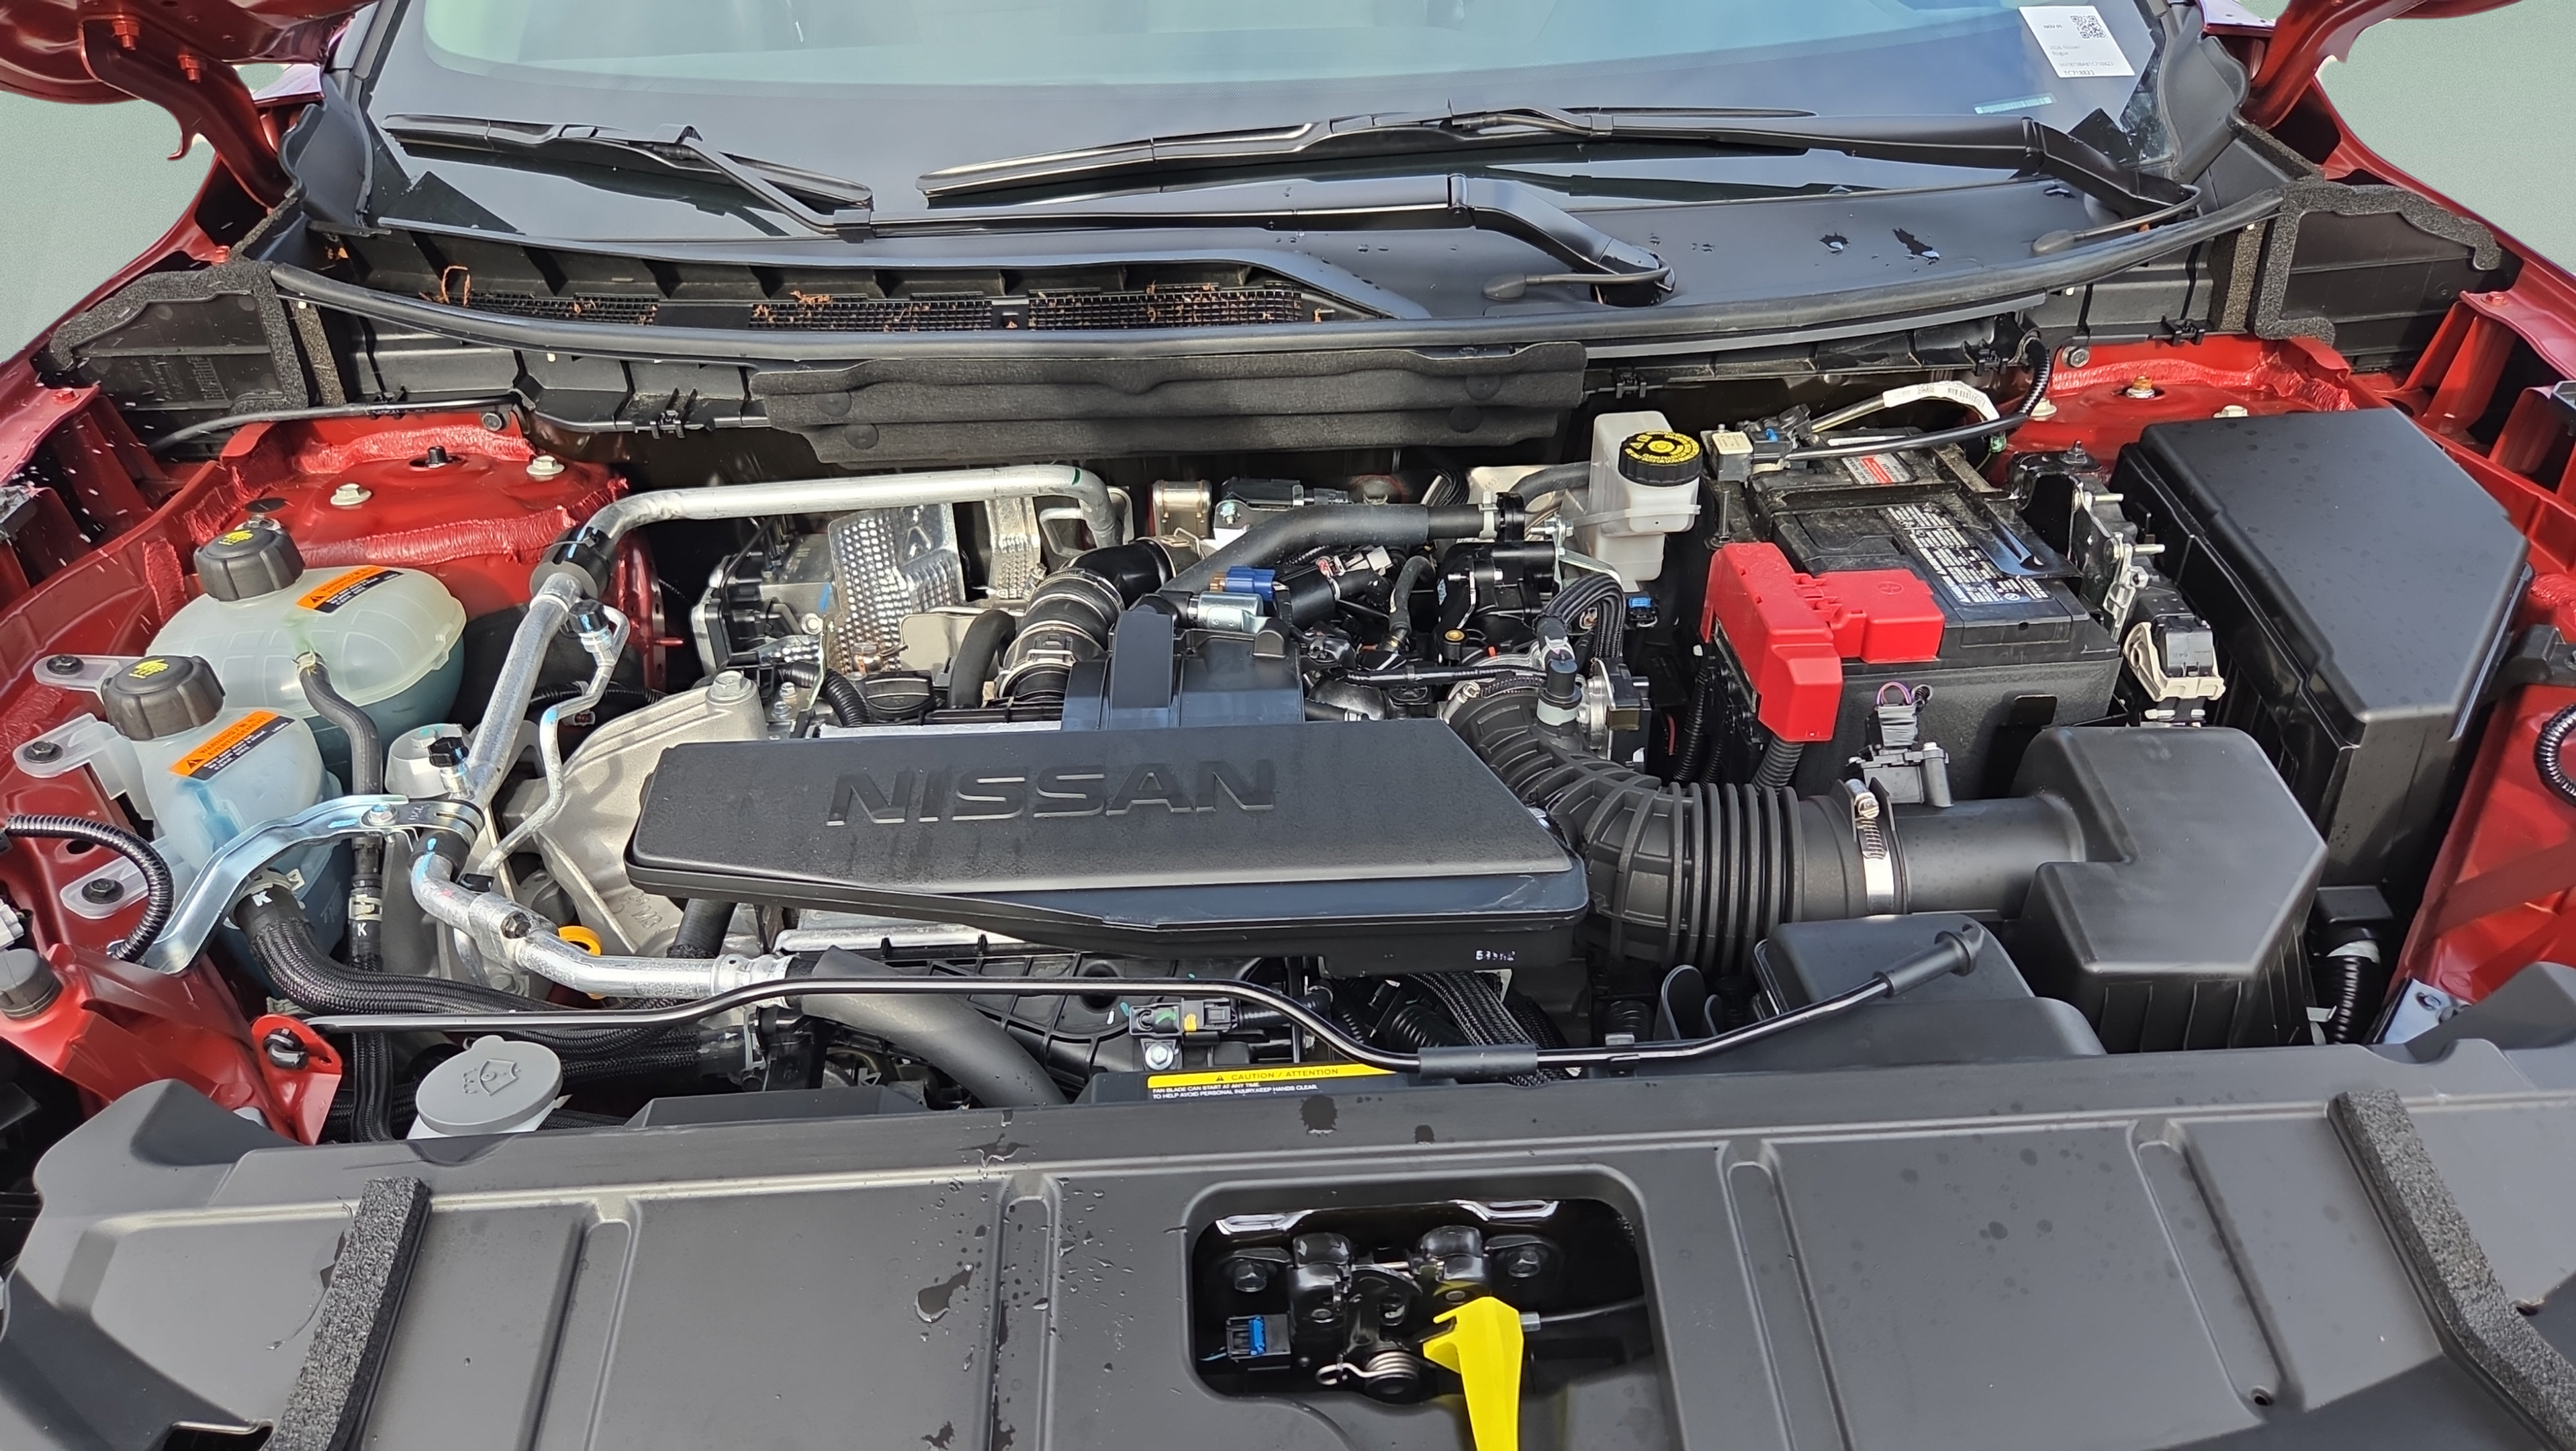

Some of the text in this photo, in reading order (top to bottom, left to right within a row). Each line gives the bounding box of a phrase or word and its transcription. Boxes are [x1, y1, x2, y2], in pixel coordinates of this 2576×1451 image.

[199, 730, 236, 754] WARNING
[208, 717, 267, 756] AVERTISSEMENT
[826, 758, 1275, 826] NISSAN
[252, 890, 273, 907] K
[357, 922, 368, 937] K
[1232, 1072, 1275, 1081] CAUTION
[1286, 1068, 1338, 1077] ATTENTION
